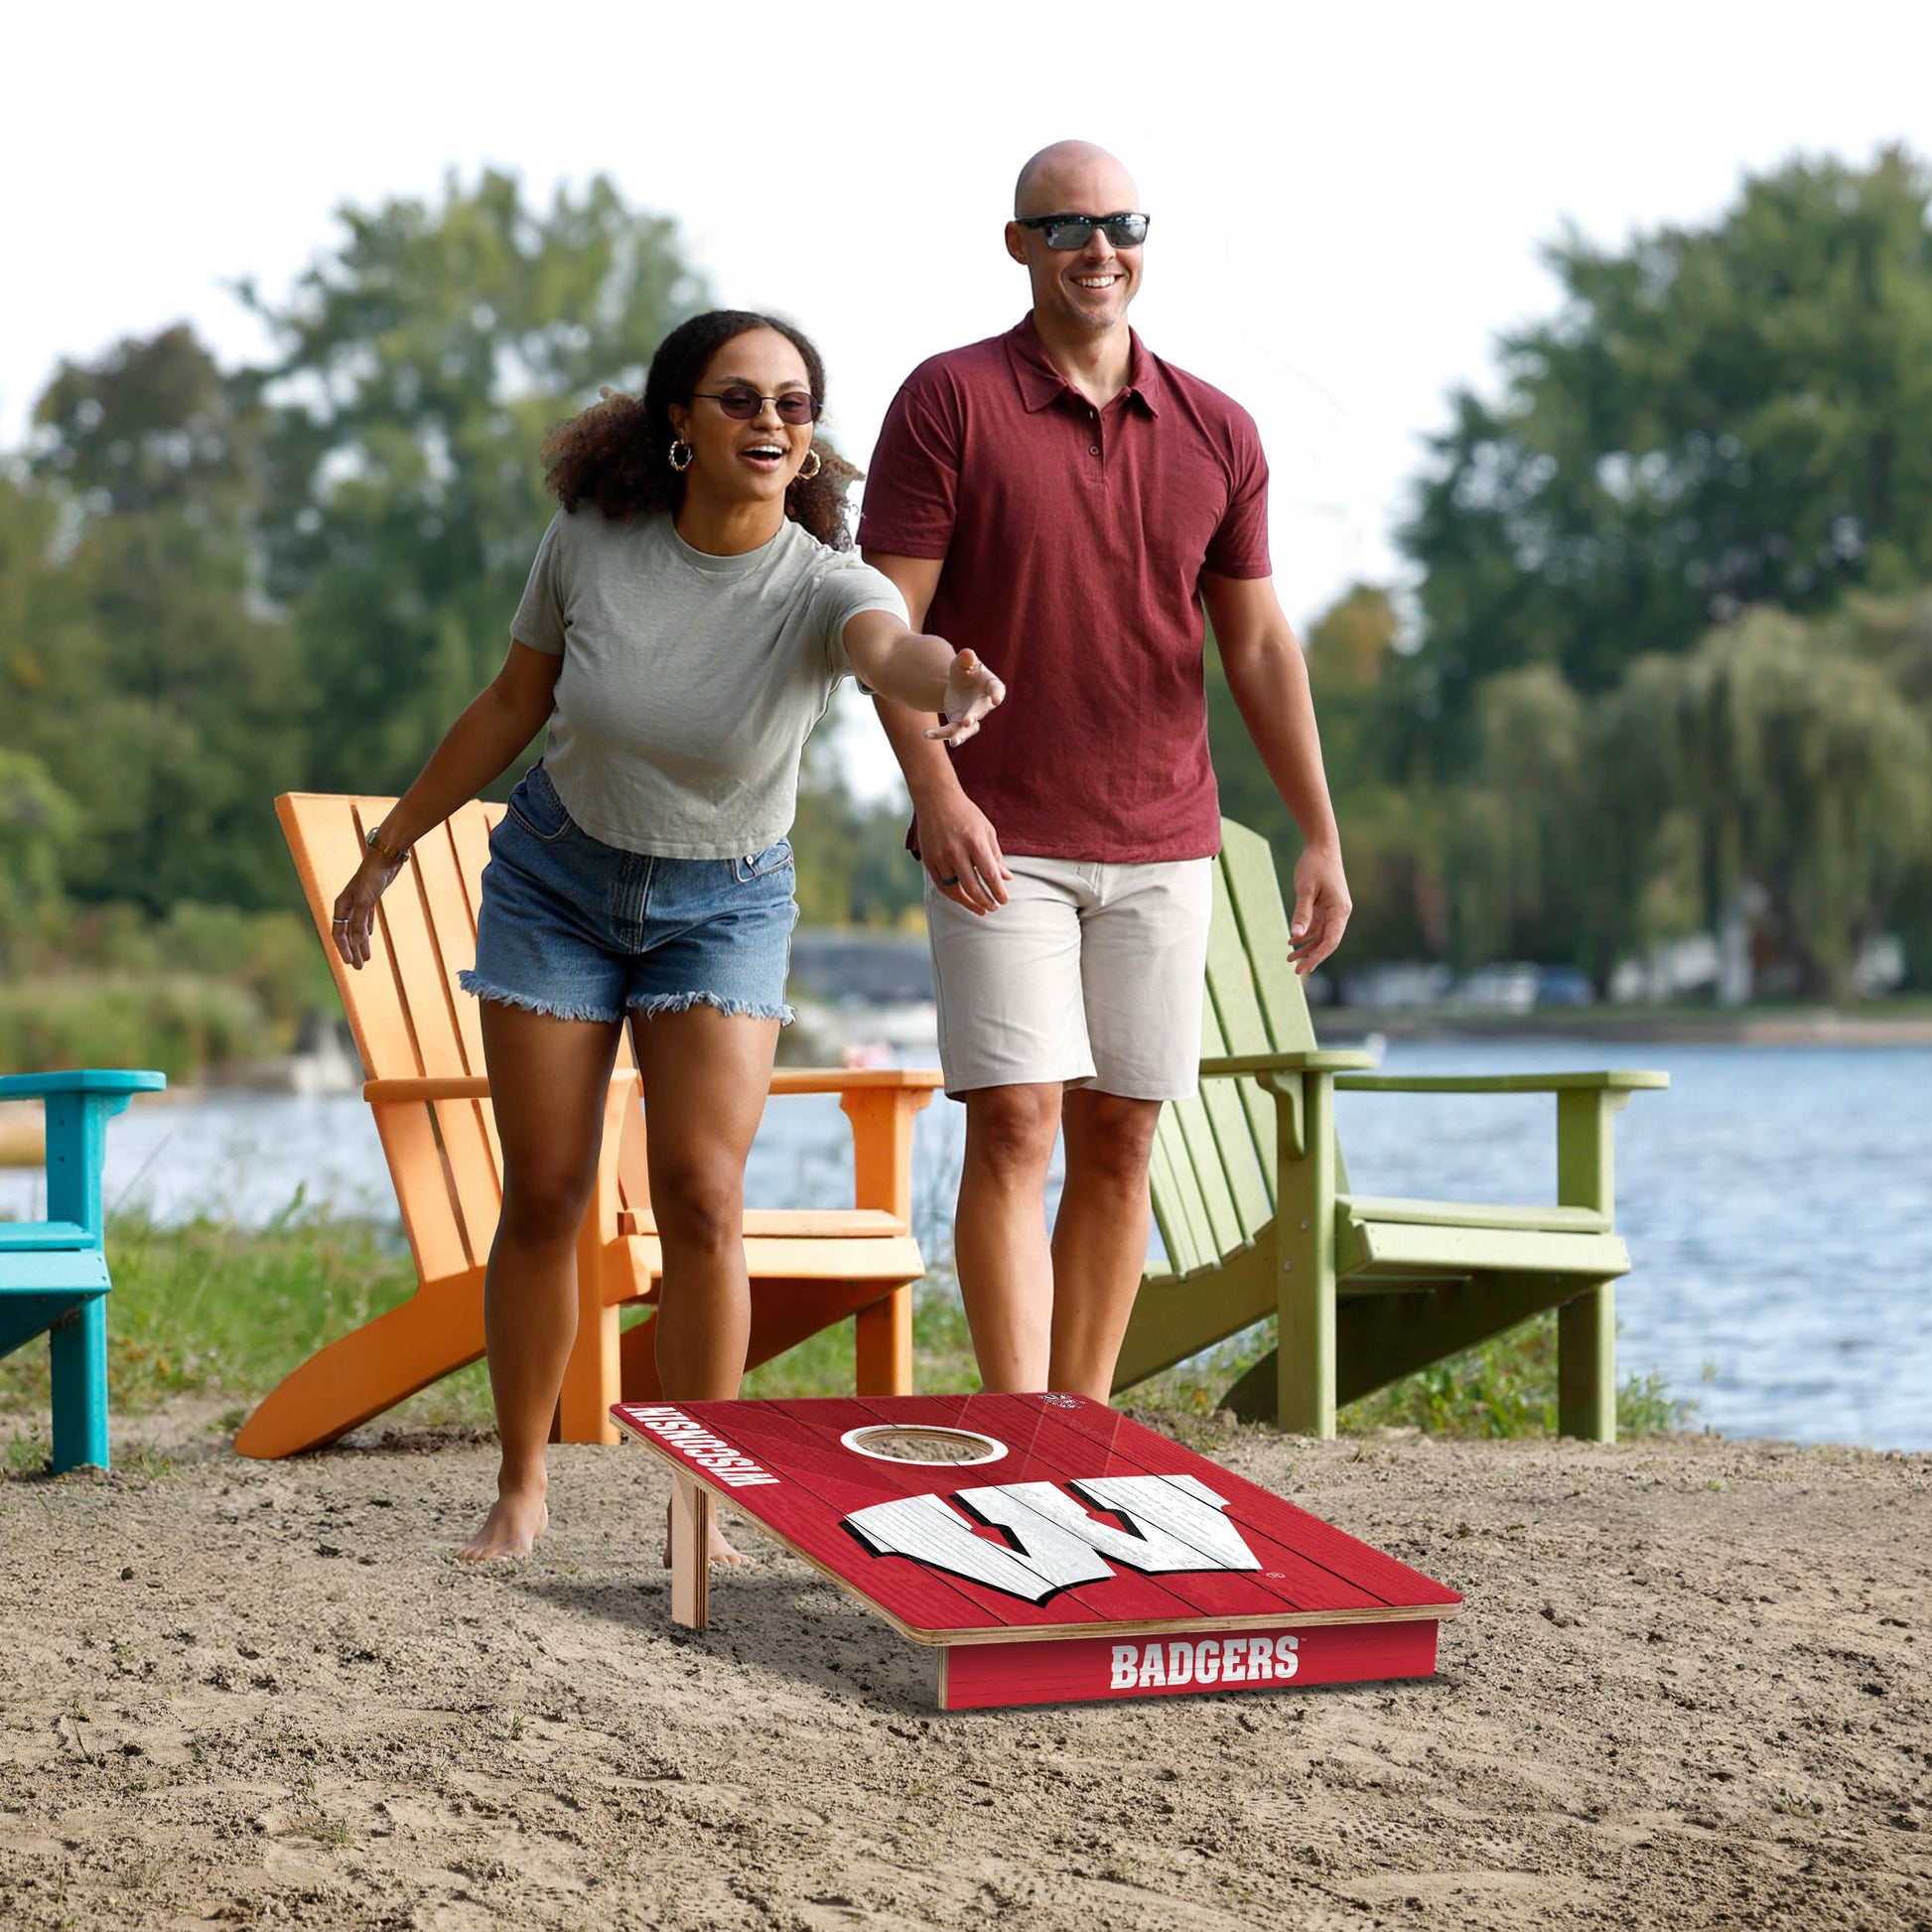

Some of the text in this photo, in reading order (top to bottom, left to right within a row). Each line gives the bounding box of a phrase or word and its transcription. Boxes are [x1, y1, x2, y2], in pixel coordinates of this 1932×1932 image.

[622, 1407, 781, 1487] WISCONSIN
[841, 1474, 1262, 1607] W
[1111, 1634, 1300, 1689] BADGERS
